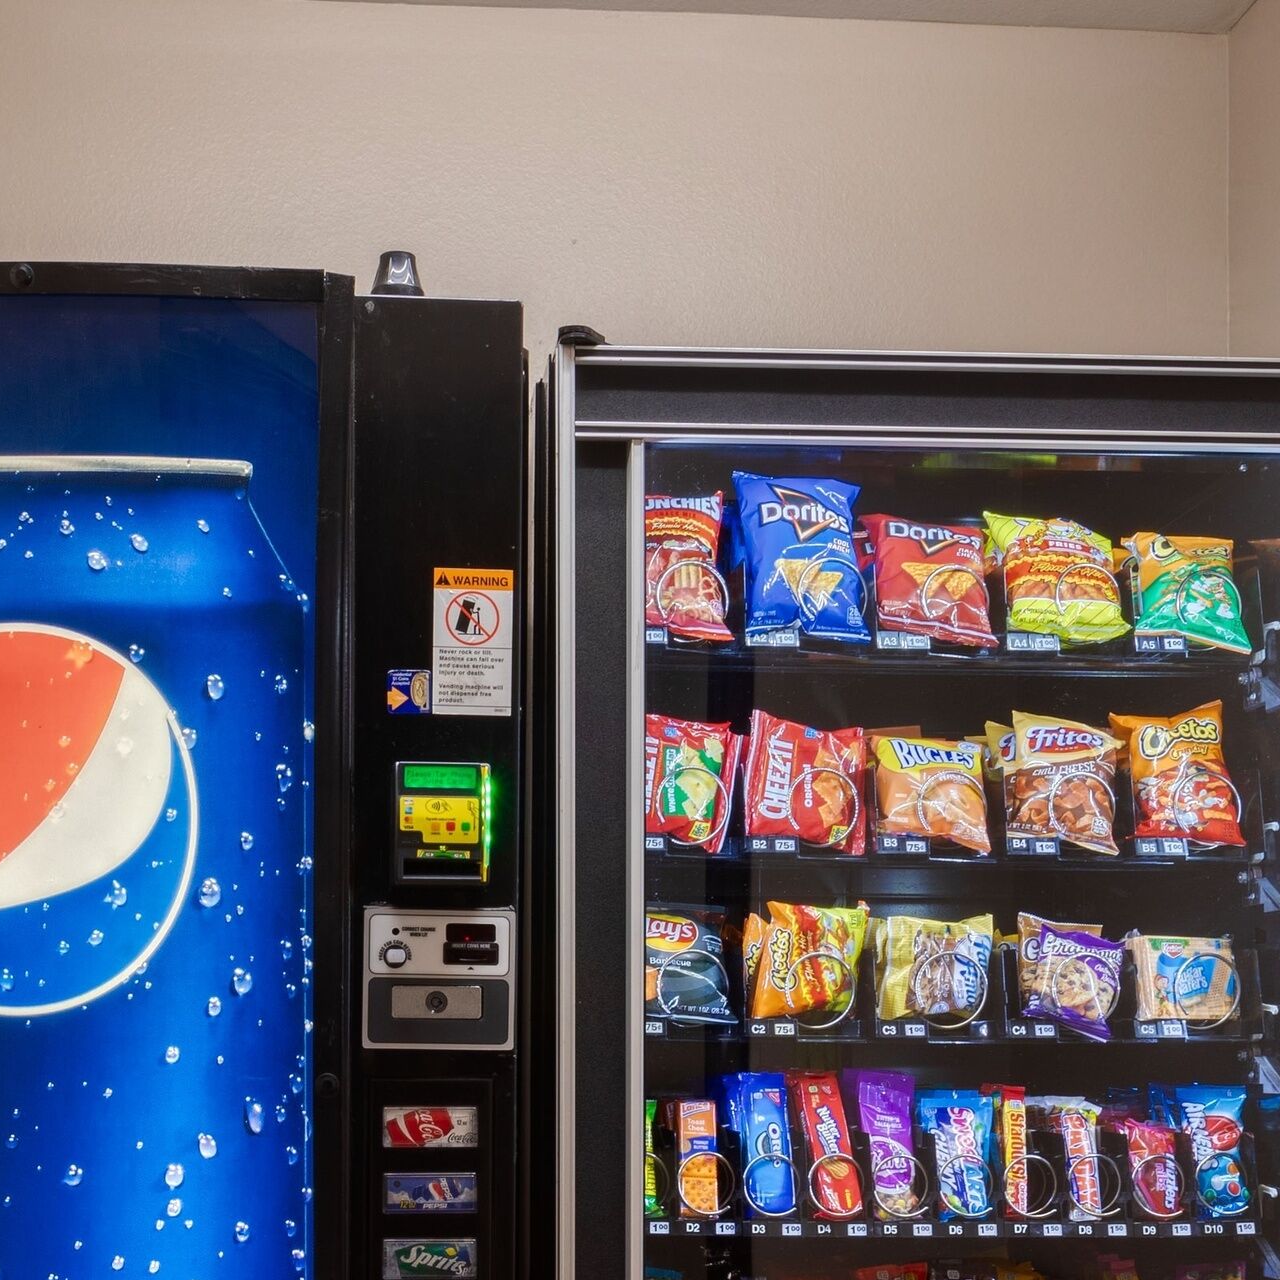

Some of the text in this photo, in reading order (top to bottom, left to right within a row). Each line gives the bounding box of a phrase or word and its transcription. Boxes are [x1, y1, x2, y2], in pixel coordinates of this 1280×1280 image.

[760, 502, 850, 534] Doritos
[888, 521, 981, 551] Doritos
[833, 538, 850, 548] COOL
[827, 543, 850, 554] RANCH
[453, 575, 509, 587] WARNING
[752, 633, 768, 643] A2
[883, 637, 897, 646] A3
[1013, 640, 1027, 648] A4
[1141, 641, 1156, 650] A5
[1026, 726, 1104, 752] Fritos
[890, 738, 974, 769] BUGLES
[1032, 761, 1097, 776] CHILI CHEESE
[753, 839, 768, 849] B2
[883, 838, 898, 847] B3
[1012, 839, 1027, 848] B4
[1142, 843, 1156, 852] B5
[751, 1025, 766, 1034] C2
[882, 1026, 897, 1035] C3
[1012, 1026, 1027, 1035] C4
[1141, 1025, 1155, 1034] C5
[817, 1106, 841, 1139] Nutter
[440, 1178, 453, 1200] PEPSI
[686, 1223, 701, 1233] D2
[751, 1224, 766, 1234] D3
[817, 1224, 832, 1234] D4
[883, 1225, 898, 1234] D5
[949, 1225, 963, 1235] D6
[1014, 1224, 1028, 1234] D7
[1078, 1225, 1093, 1235] D8
[1143, 1225, 1157, 1235] D9
[1204, 1224, 1223, 1234] D10
[400, 1245, 464, 1272] Sprite
